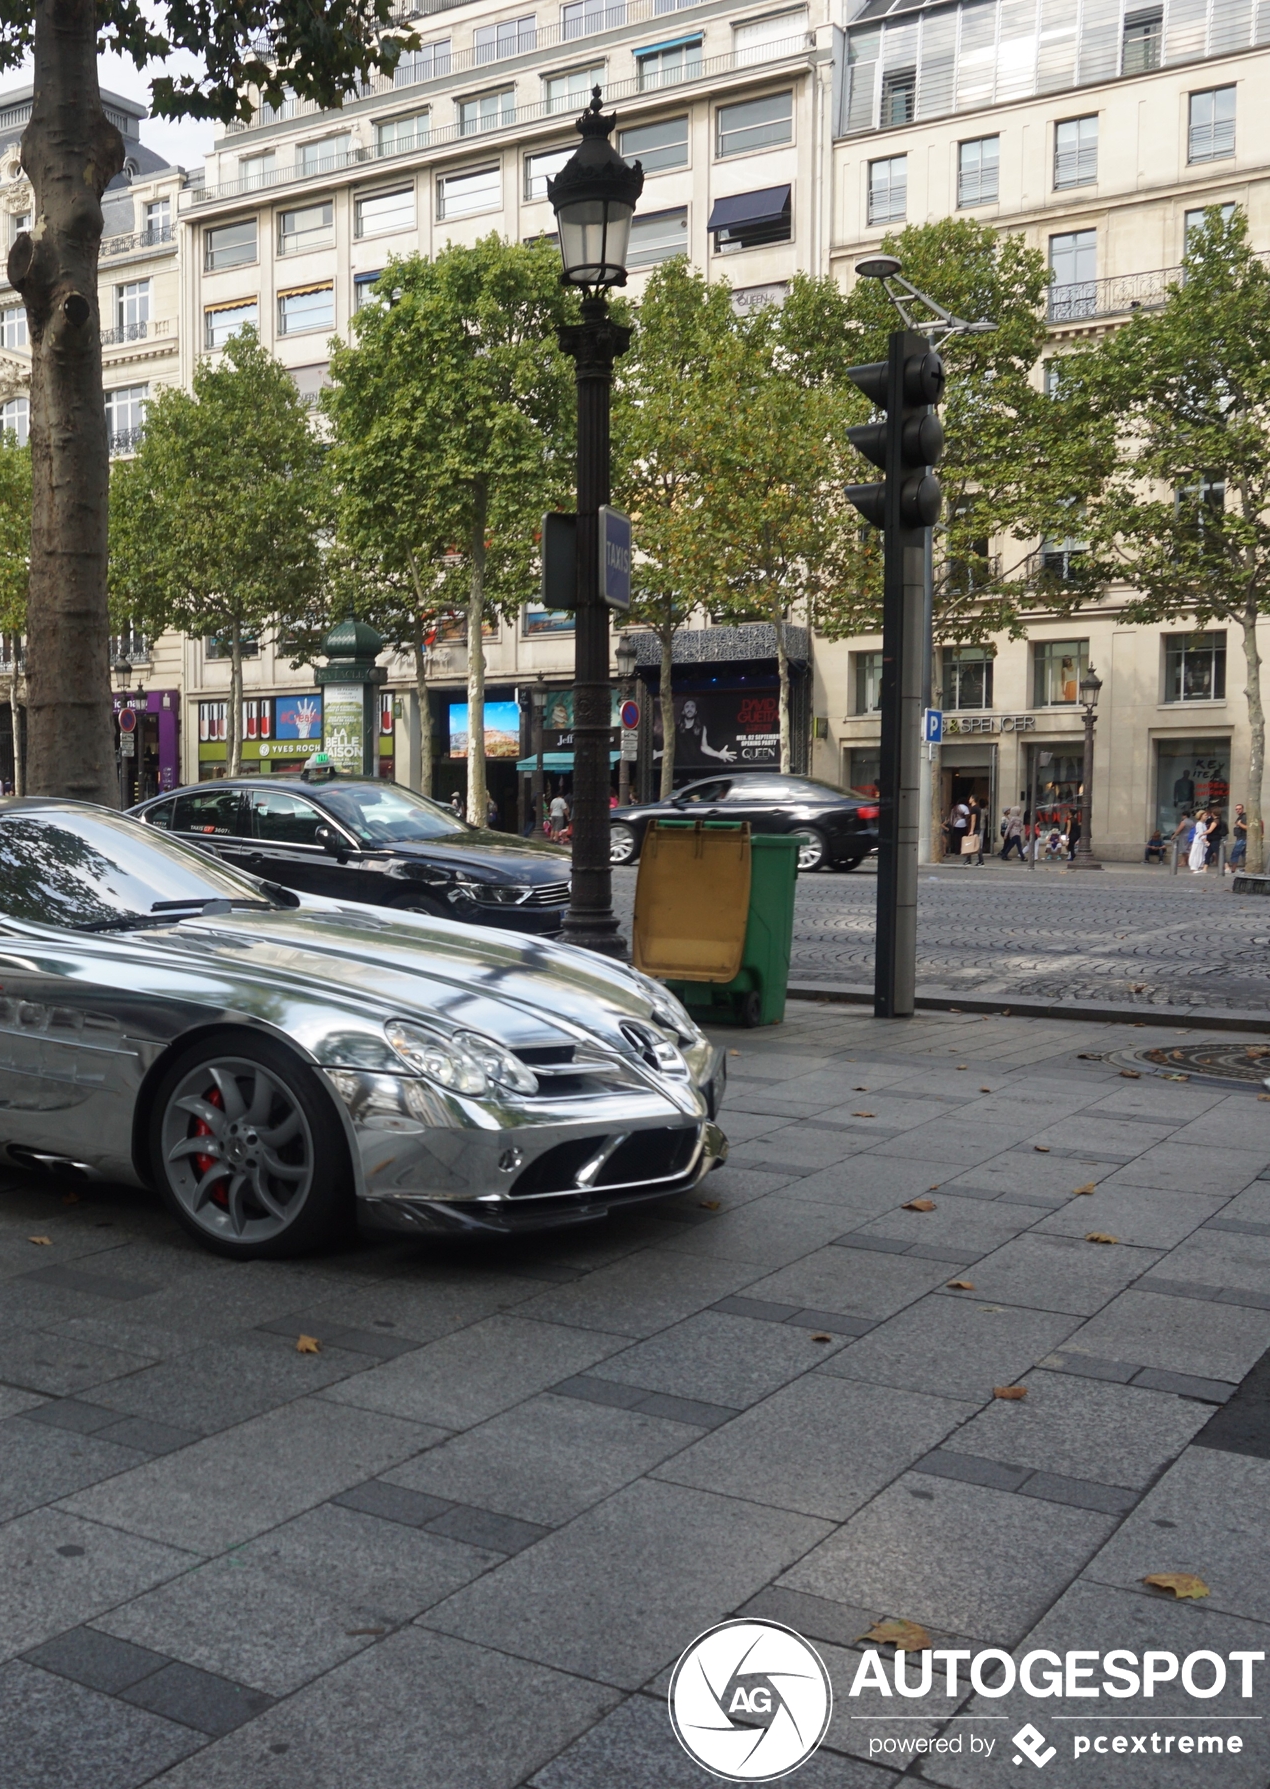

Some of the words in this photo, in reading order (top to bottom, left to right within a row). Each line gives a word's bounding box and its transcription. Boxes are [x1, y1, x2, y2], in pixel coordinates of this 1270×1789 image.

[606, 540, 629, 573] TAXIS
[742, 697, 777, 711] DAVID
[930, 715, 939, 737] P
[949, 719, 959, 733] &
[960, 715, 1036, 733] SPENCER
[334, 727, 347, 737] LA
[325, 736, 359, 748] BELLE
[272, 745, 294, 753] YVES
[741, 747, 776, 759] QUEEN
